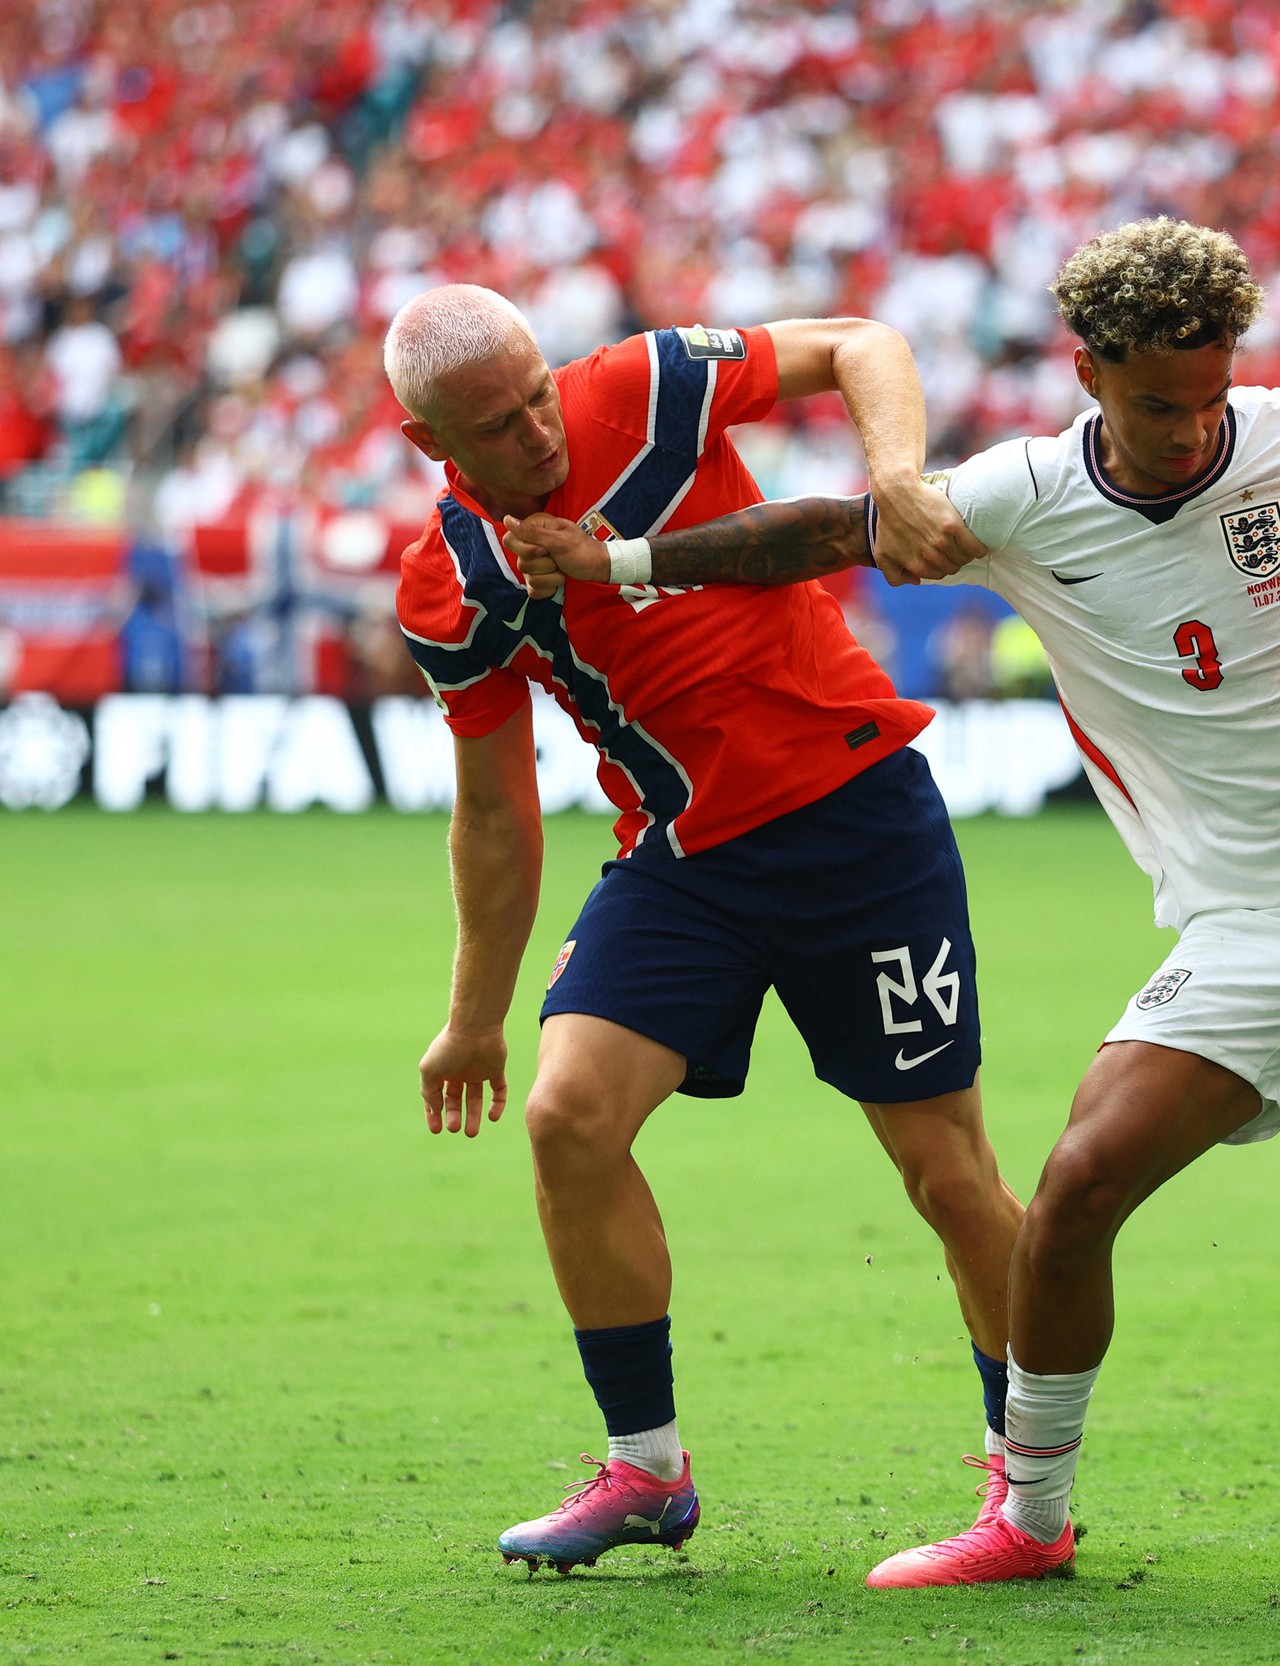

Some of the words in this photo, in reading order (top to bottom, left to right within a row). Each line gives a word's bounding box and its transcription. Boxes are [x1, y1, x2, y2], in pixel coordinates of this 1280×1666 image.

[1173, 619, 1225, 692] 3
[93, 693, 376, 813] FIFA
[871, 936, 960, 1035] 26
